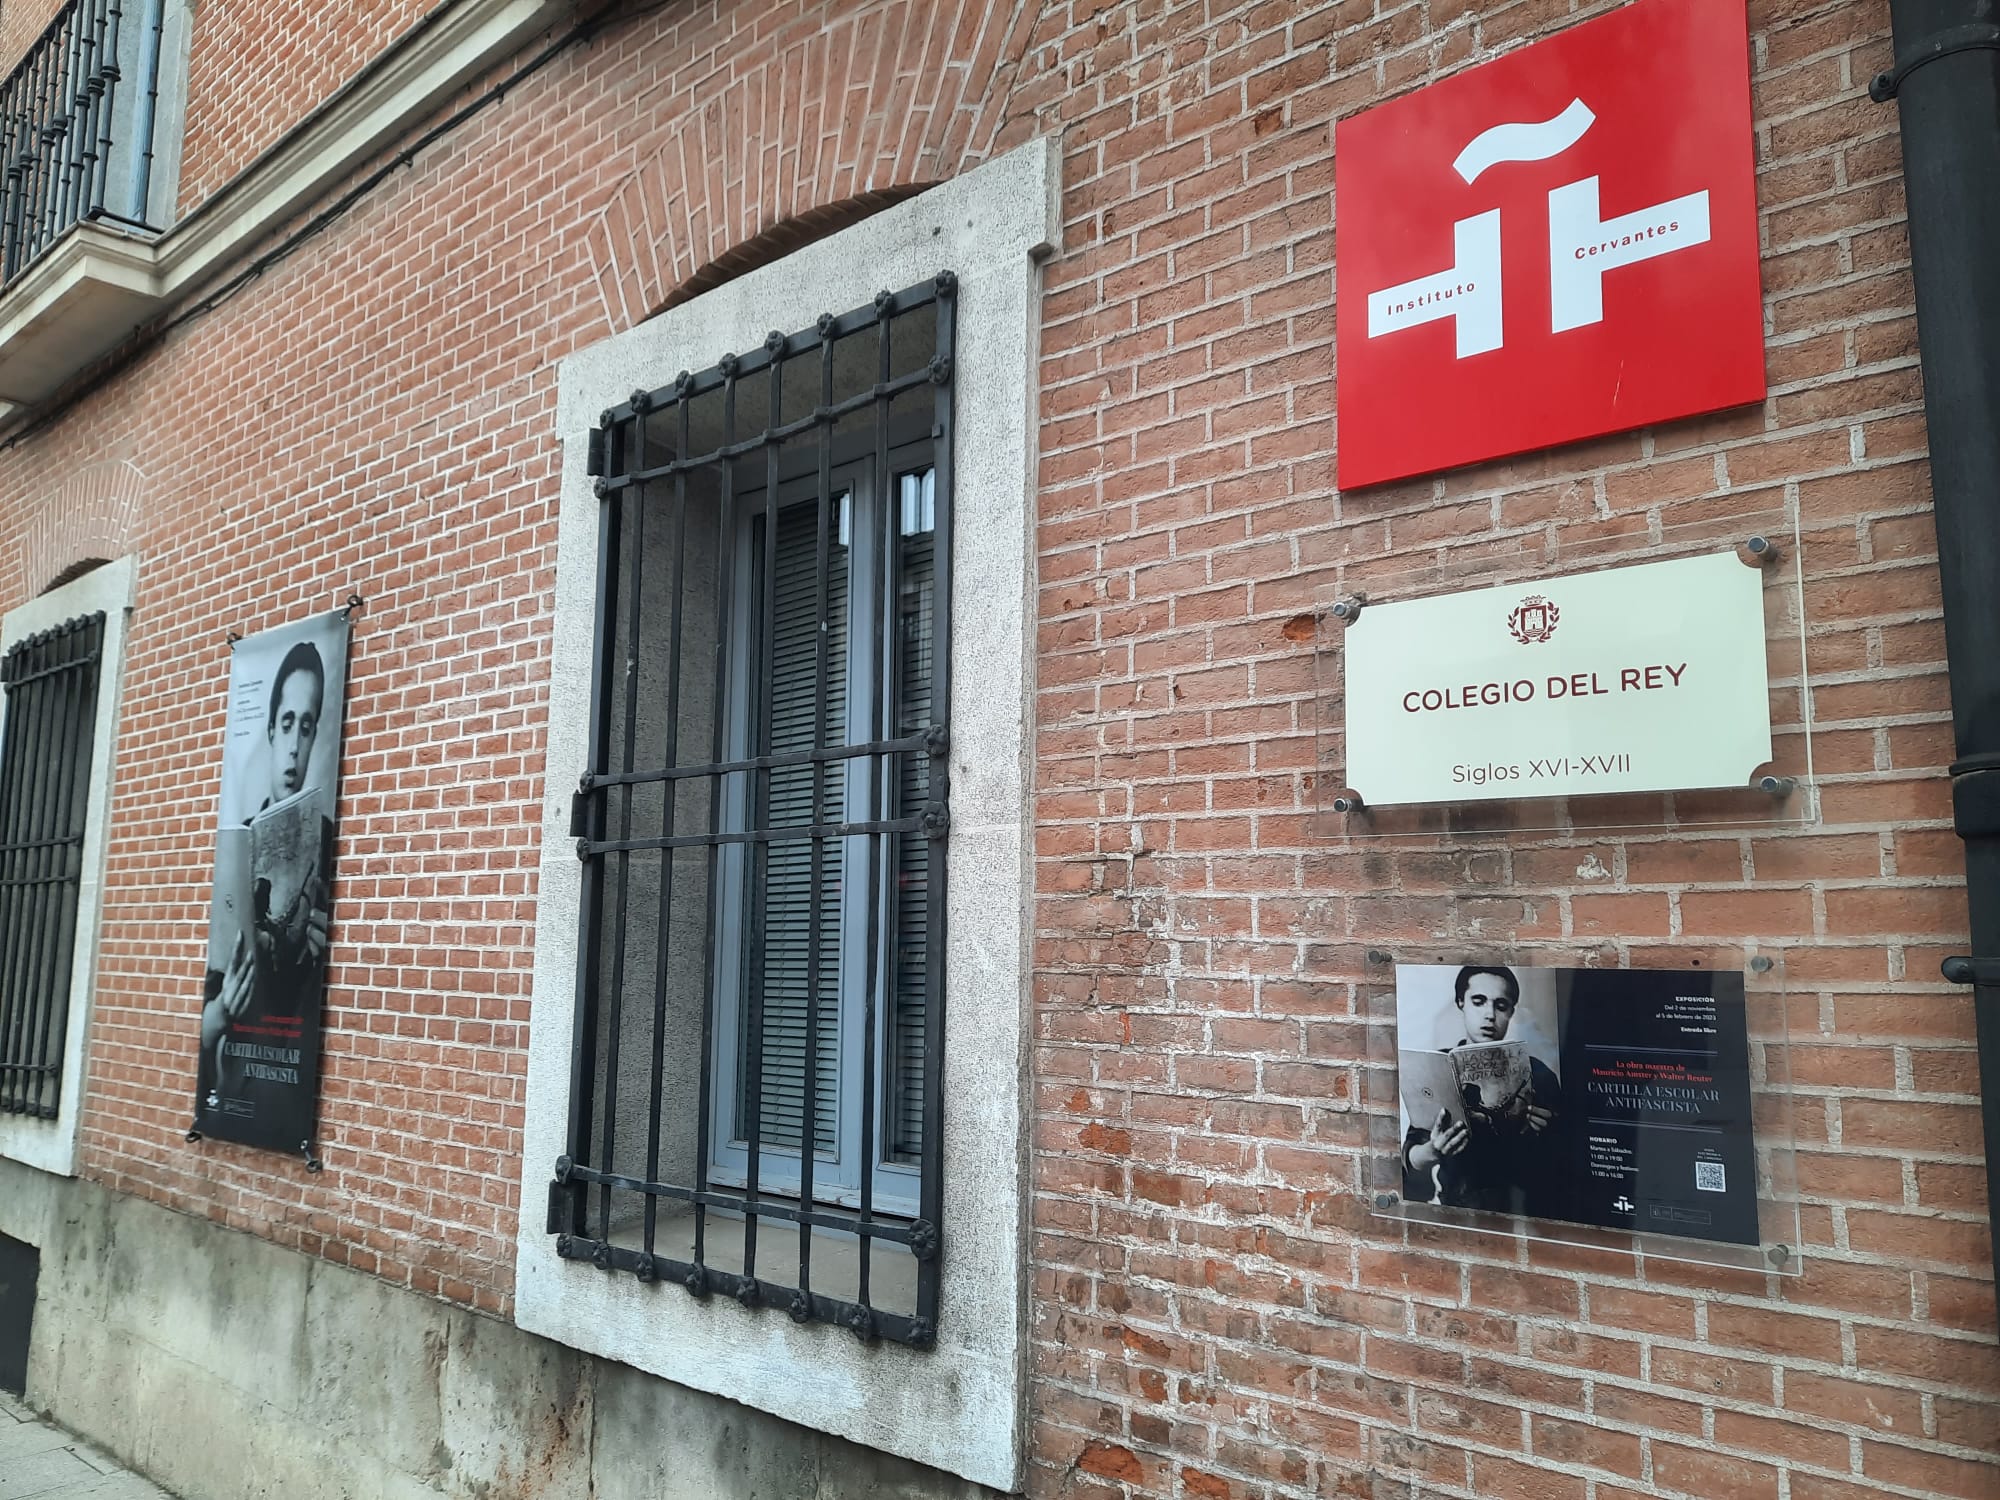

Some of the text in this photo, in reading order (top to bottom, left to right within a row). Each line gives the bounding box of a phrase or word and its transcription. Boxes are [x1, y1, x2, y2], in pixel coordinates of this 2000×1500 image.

[1387, 219, 1680, 316] Instituto Cervantes
[1403, 663, 1688, 713] COLEGIO DEL REY
[1452, 754, 1631, 785] Siglos XVI-XVII
[1592, 1067, 1624, 1077] Mauricio
[1659, 1072, 1685, 1081] Walter
[1616, 1060, 1624, 1068] La
[1626, 1061, 1643, 1069] obra
[1675, 1064, 1685, 1072] de
[1587, 1081, 1720, 1103] CARTILLA ESCOLAR
[1606, 1096, 1701, 1114] ANTIFASCISTA
